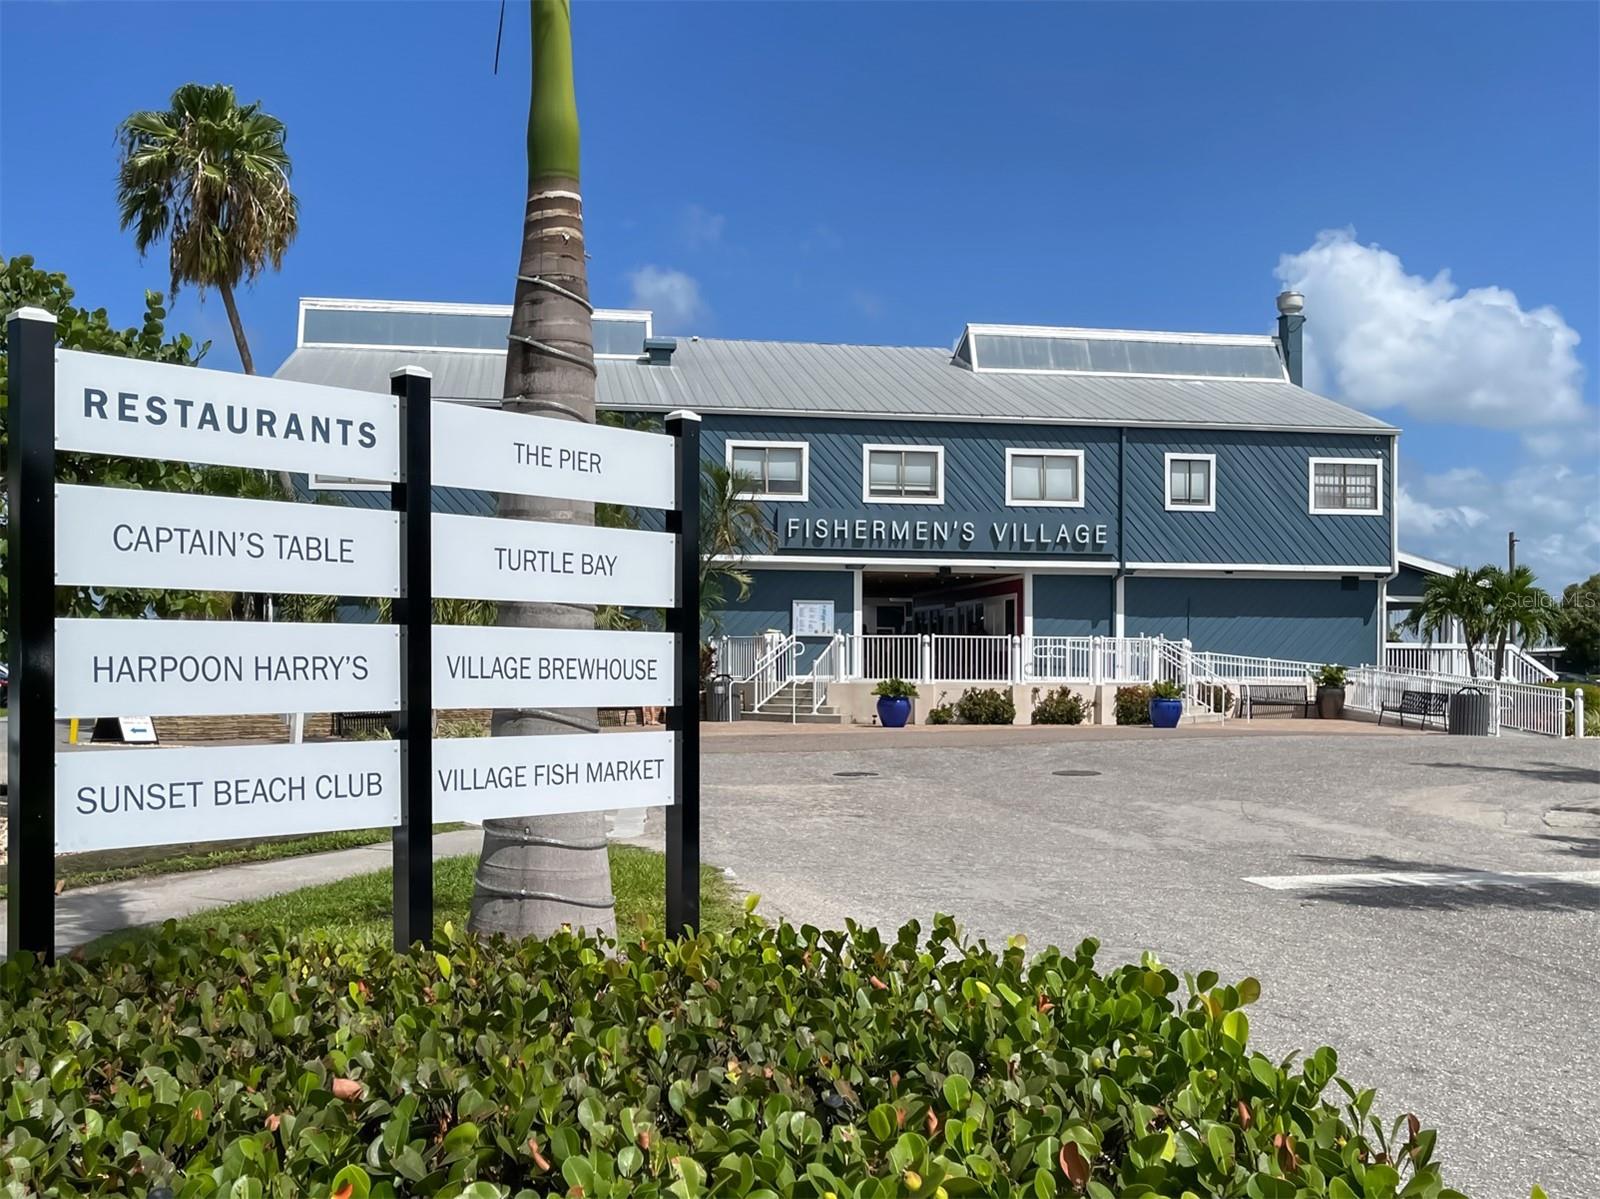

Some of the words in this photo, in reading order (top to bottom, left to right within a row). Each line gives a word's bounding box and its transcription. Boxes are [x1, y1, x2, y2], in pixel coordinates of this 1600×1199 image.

[84, 388, 377, 449] RESTAURANTS
[514, 442, 553, 468] THE
[559, 448, 602, 474] PIER
[113, 524, 265, 560] CAPTAIN'S
[273, 534, 355, 564] TABLE
[788, 517, 976, 542] FISHERMEN'S
[993, 522, 1108, 545] VILLAGE
[495, 547, 574, 574] TURTLE
[581, 553, 618, 577] BAY
[93, 655, 244, 683] HARPOON
[254, 655, 369, 682] HARRY'S
[446, 655, 532, 681] VILLAGE
[538, 657, 658, 681] BREWHOUSE
[438, 765, 527, 792] VILLAGE
[534, 763, 579, 786] FISH
[586, 758, 665, 783] MARKET
[76, 781, 204, 815] SUNSET
[214, 775, 306, 806] BEACH
[315, 771, 383, 801] CLUB
